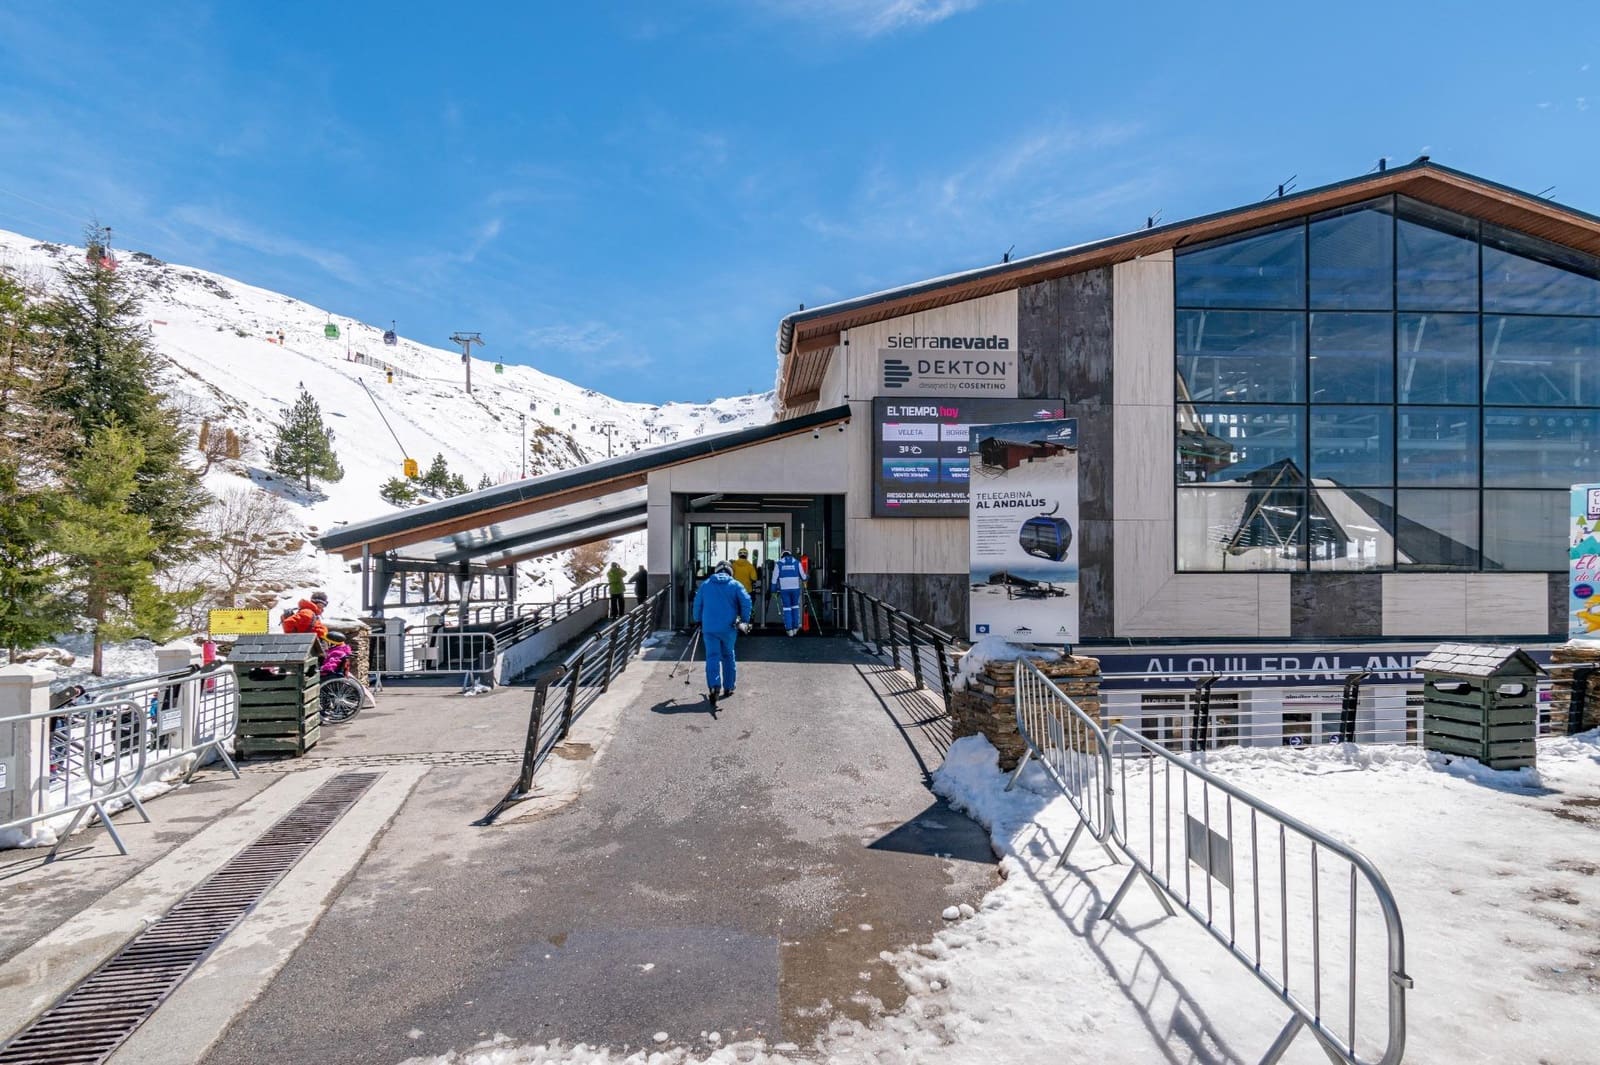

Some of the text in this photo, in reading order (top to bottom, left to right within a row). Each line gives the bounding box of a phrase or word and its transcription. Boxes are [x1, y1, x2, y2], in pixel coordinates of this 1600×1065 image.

[887, 333, 1009, 350] sierranevada
[919, 382, 948, 391] designed
[887, 406, 899, 417] EL
[940, 406, 959, 418] hoy
[976, 490, 1032, 500] TELECABINA
[976, 499, 990, 509] AL
[992, 498, 1046, 509] ANDALUS
[1143, 657, 1301, 682] ALQUILER
